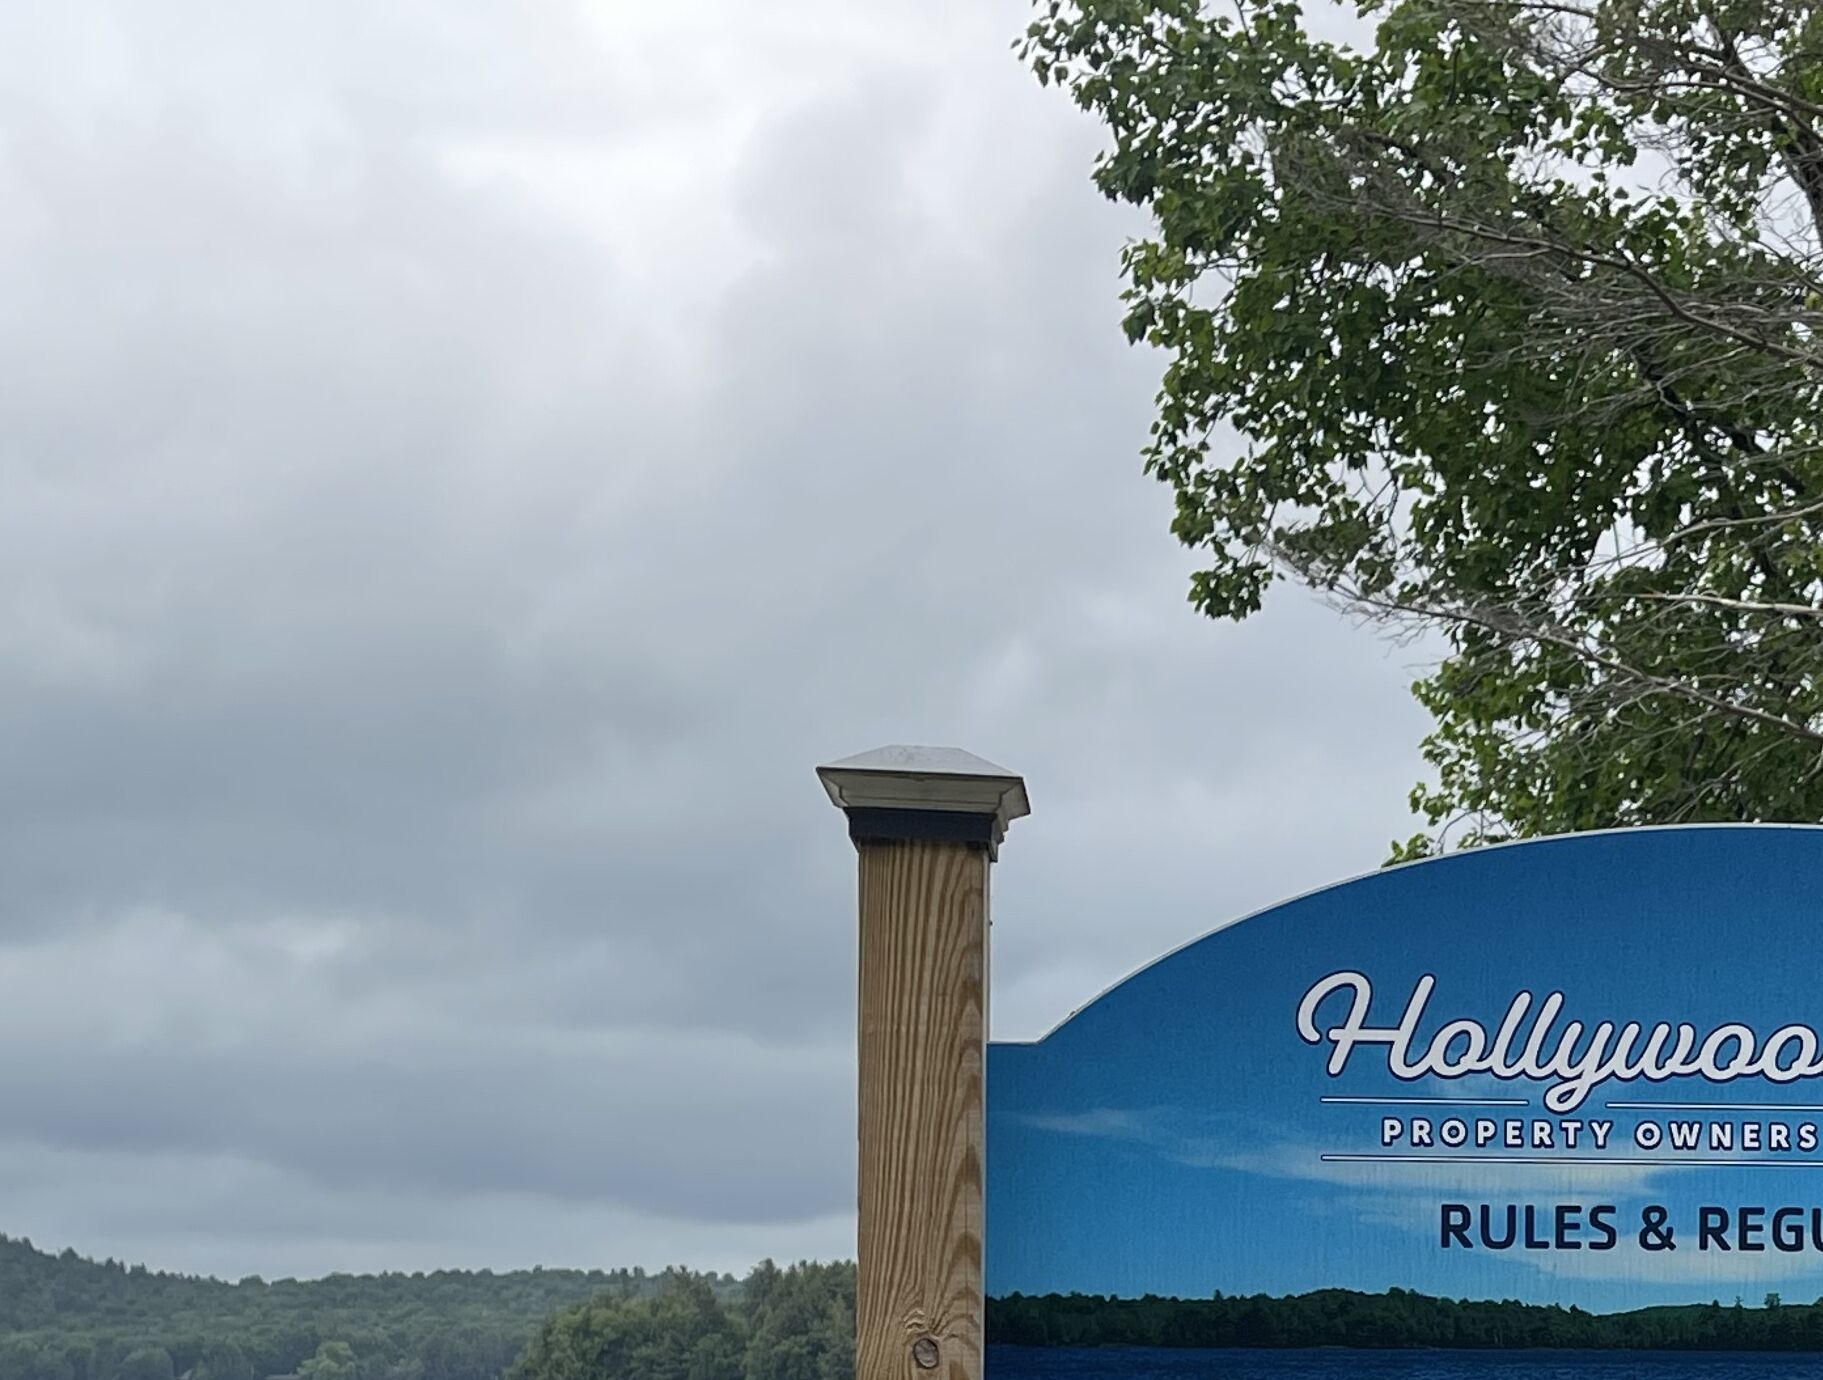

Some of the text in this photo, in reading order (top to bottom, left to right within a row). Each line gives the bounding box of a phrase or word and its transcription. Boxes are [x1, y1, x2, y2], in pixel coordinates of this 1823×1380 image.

[1382, 1116, 1615, 1150] PROPERTY
[1634, 1119, 1819, 1152] OWNERS
[1438, 1202, 1618, 1251] RULES
[1638, 1203, 1677, 1253] &
